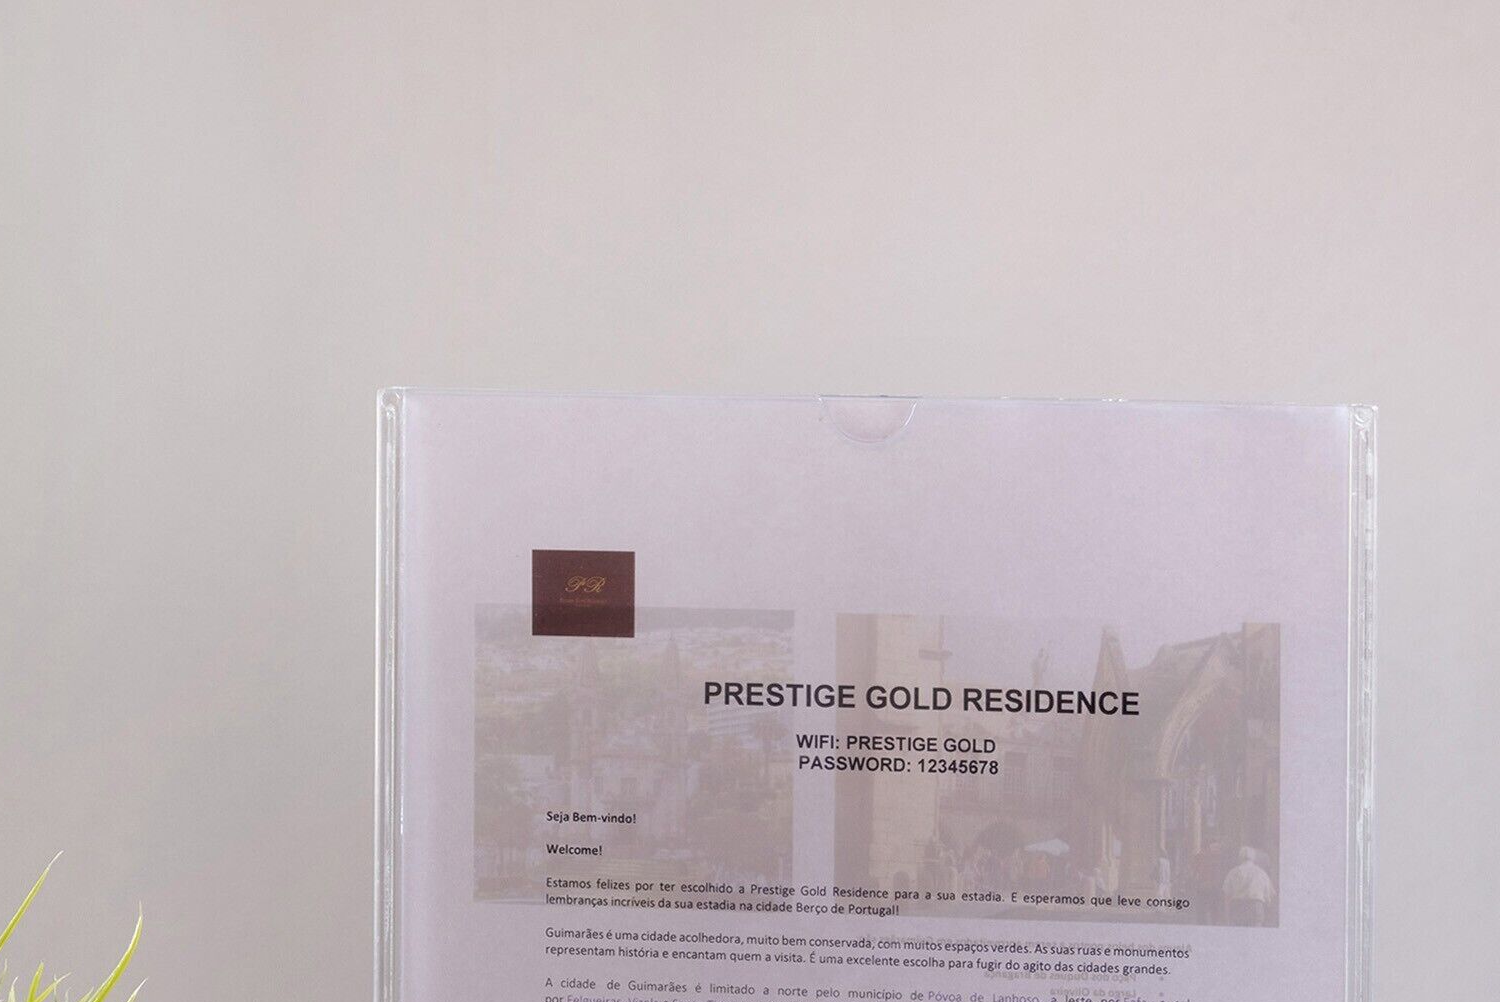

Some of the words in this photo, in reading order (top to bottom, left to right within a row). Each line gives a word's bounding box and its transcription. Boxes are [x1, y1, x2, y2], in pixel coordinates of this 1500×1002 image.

[704, 682, 856, 708] PRESTIGE
[866, 685, 952, 711] GOLD
[963, 687, 1140, 716] RESIDENCE
[796, 734, 840, 750] WIFI:
[847, 735, 938, 752] PRESTIGE
[943, 738, 996, 753] GOLD
[799, 755, 911, 772] PASSWORD:
[918, 758, 999, 775] 12345678
[546, 811, 569, 823] Seja
[572, 811, 636, 824] Bem-vindo!
[546, 844, 602, 856] Welcome!
[546, 878, 591, 888] Estamos
[596, 879, 629, 890] felizes
[635, 882, 654, 892] por
[659, 881, 675, 891] ter
[681, 882, 732, 893] escolhido
[751, 884, 795, 897] Prestige
[800, 886, 825, 896] Gold
[833, 887, 888, 898] Residence
[895, 891, 918, 900] para
[937, 892, 955, 900] sua
[961, 891, 1004, 901] estadia.
[1011, 892, 1017, 902] E
[1023, 895, 1085, 905] esperamos
[1090, 897, 1111, 906] que
[1118, 895, 1140, 906] leve
[1146, 897, 1190, 909] consigo
[546, 894, 608, 907] lembranças
[611, 896, 655, 907] incríveis
[658, 897, 670, 908] da
[674, 900, 692, 908] sua
[696, 899, 735, 910] estadia
[756, 901, 792, 912] cidade
[796, 903, 828, 915] Berço
[830, 903, 844, 913] de
[849, 904, 898, 917] Portugal!
[545, 928, 603, 939] Guimarães
[606, 929, 612, 939] é
[615, 932, 638, 940] uma
[641, 930, 676, 941] cidade
[679, 932, 744, 945] acolhedora,
[747, 934, 779, 945] muito
[782, 935, 806, 946] bem
[809, 938, 875, 949] conservada,
[877, 941, 900, 949] com
[904, 940, 942, 950] muitos
[944, 943, 988, 953] espaços
[990, 942, 1032, 953] verdes.
[1033, 944, 1047, 954] As
[1050, 946, 1075, 954] suas
[1077, 947, 1102, 955] ruas
[1103, 948, 1110, 956] e
[1113, 948, 1189, 958] monumentos
[546, 946, 614, 956] representam
[618, 946, 658, 957] história
[662, 950, 668, 958] e
[672, 950, 725, 960] encantam
[729, 953, 760, 962] quem
[774, 952, 805, 962] visita.
[810, 951, 815, 963] É
[819, 956, 842, 964] uma
[846, 955, 899, 966] excelente
[902, 957, 944, 967] escolha
[948, 960, 972, 969] para
[976, 958, 1002, 971] fugir
[1004, 959, 1019, 970] do
[1023, 960, 1051, 972] agito
[1053, 961, 1073, 971] das
[1077, 962, 1119, 973] cidades
[1122, 964, 1170, 975] grandes.
